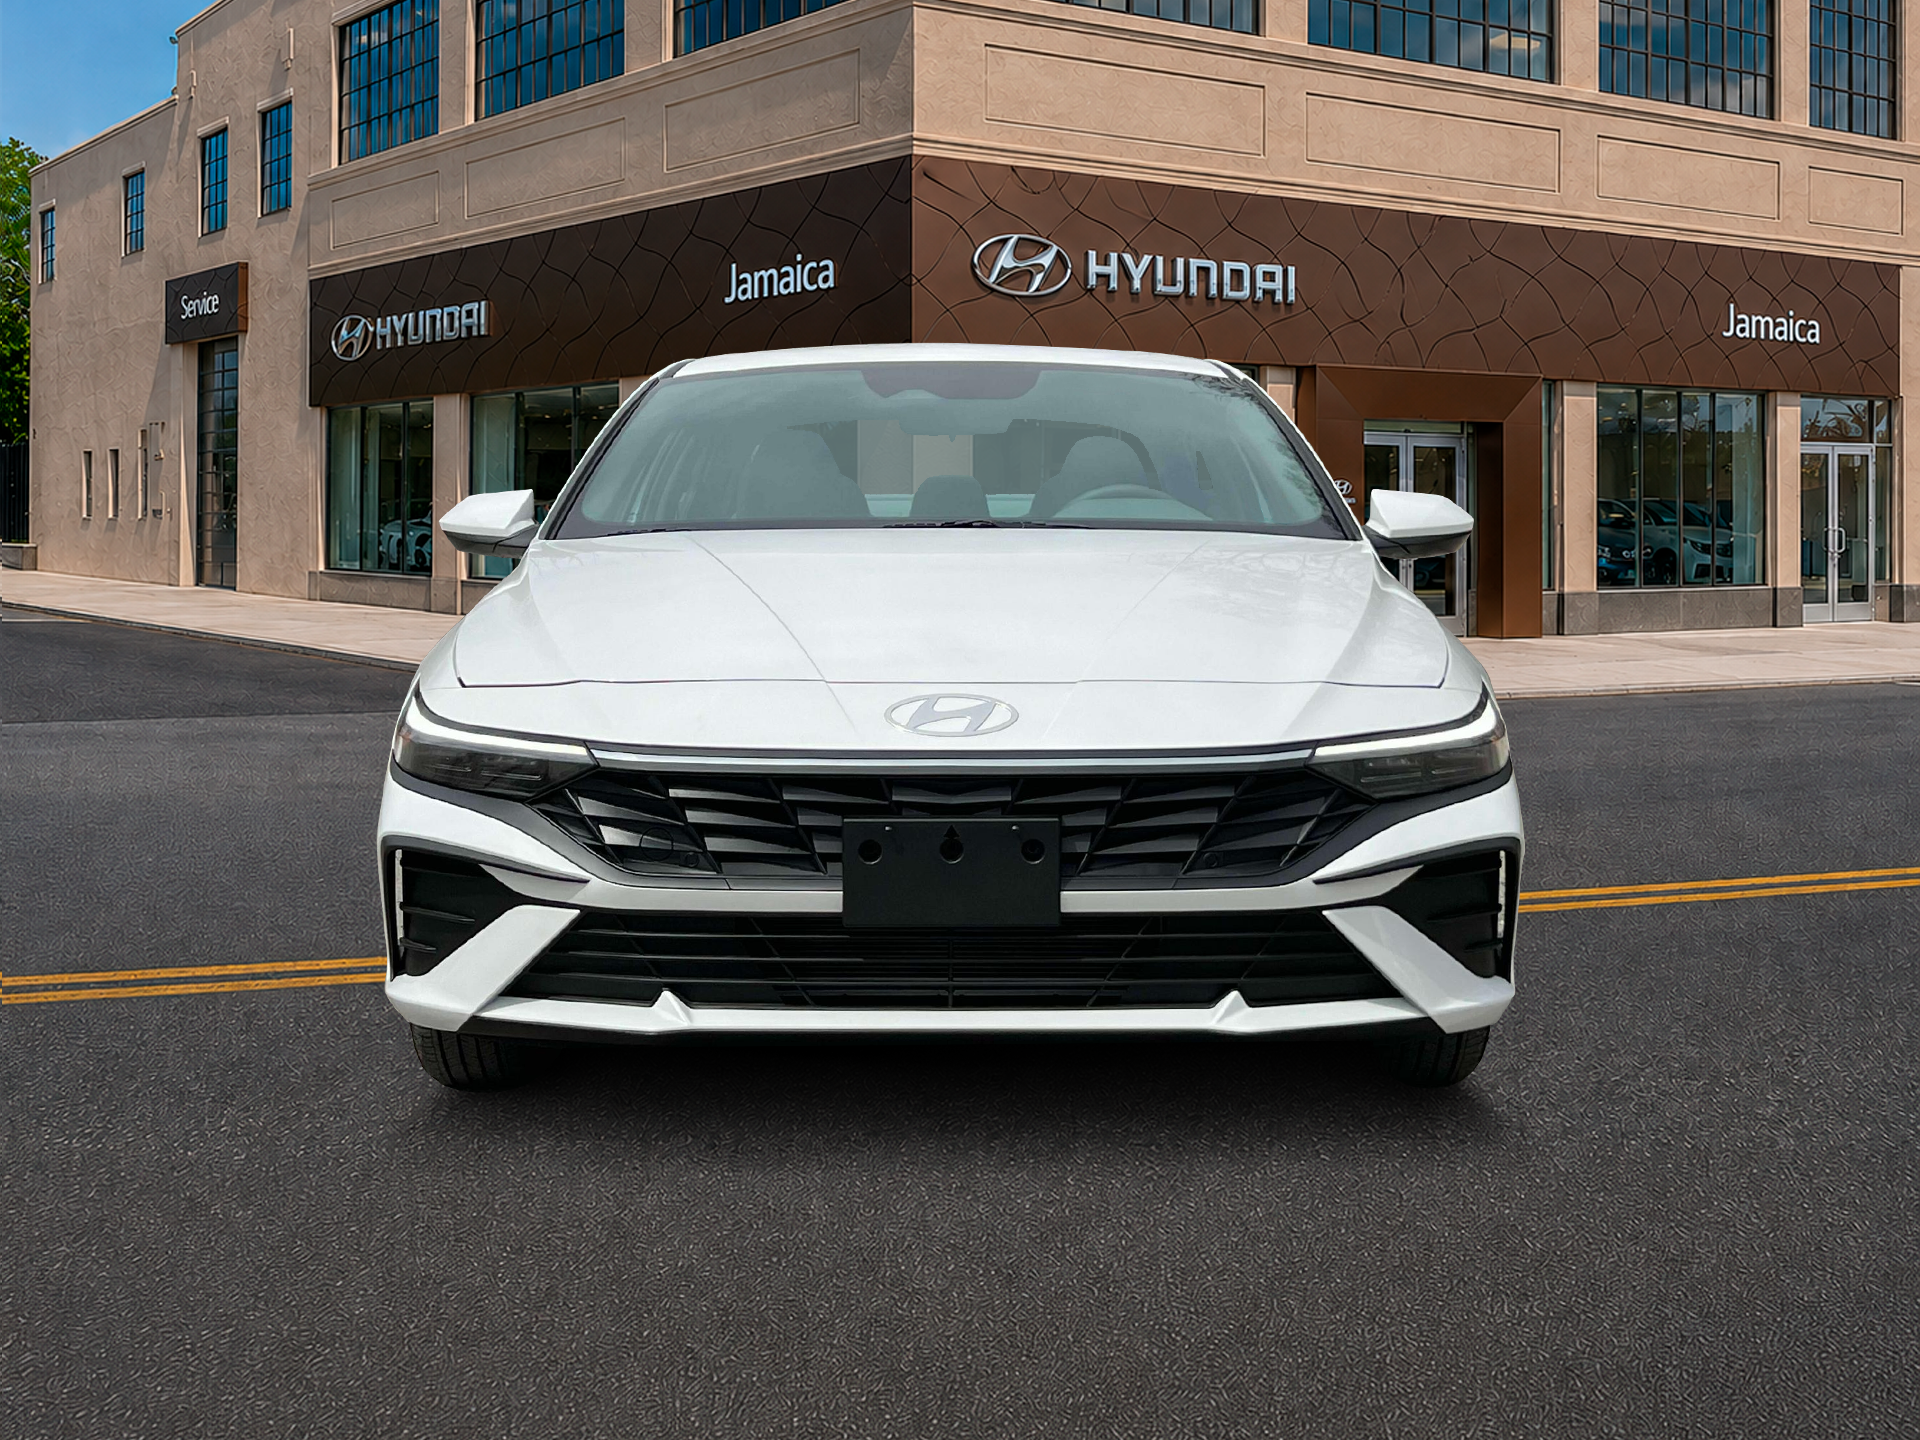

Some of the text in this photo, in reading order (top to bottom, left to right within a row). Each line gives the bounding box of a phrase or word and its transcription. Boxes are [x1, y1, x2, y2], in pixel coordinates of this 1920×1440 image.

[724, 253, 835, 304] Jamaica
[1086, 249, 1296, 304] HYUNDAI
[180, 291, 220, 320] Service
[375, 300, 490, 350] HYUNDAI
[1722, 303, 1820, 344] Jamaica
